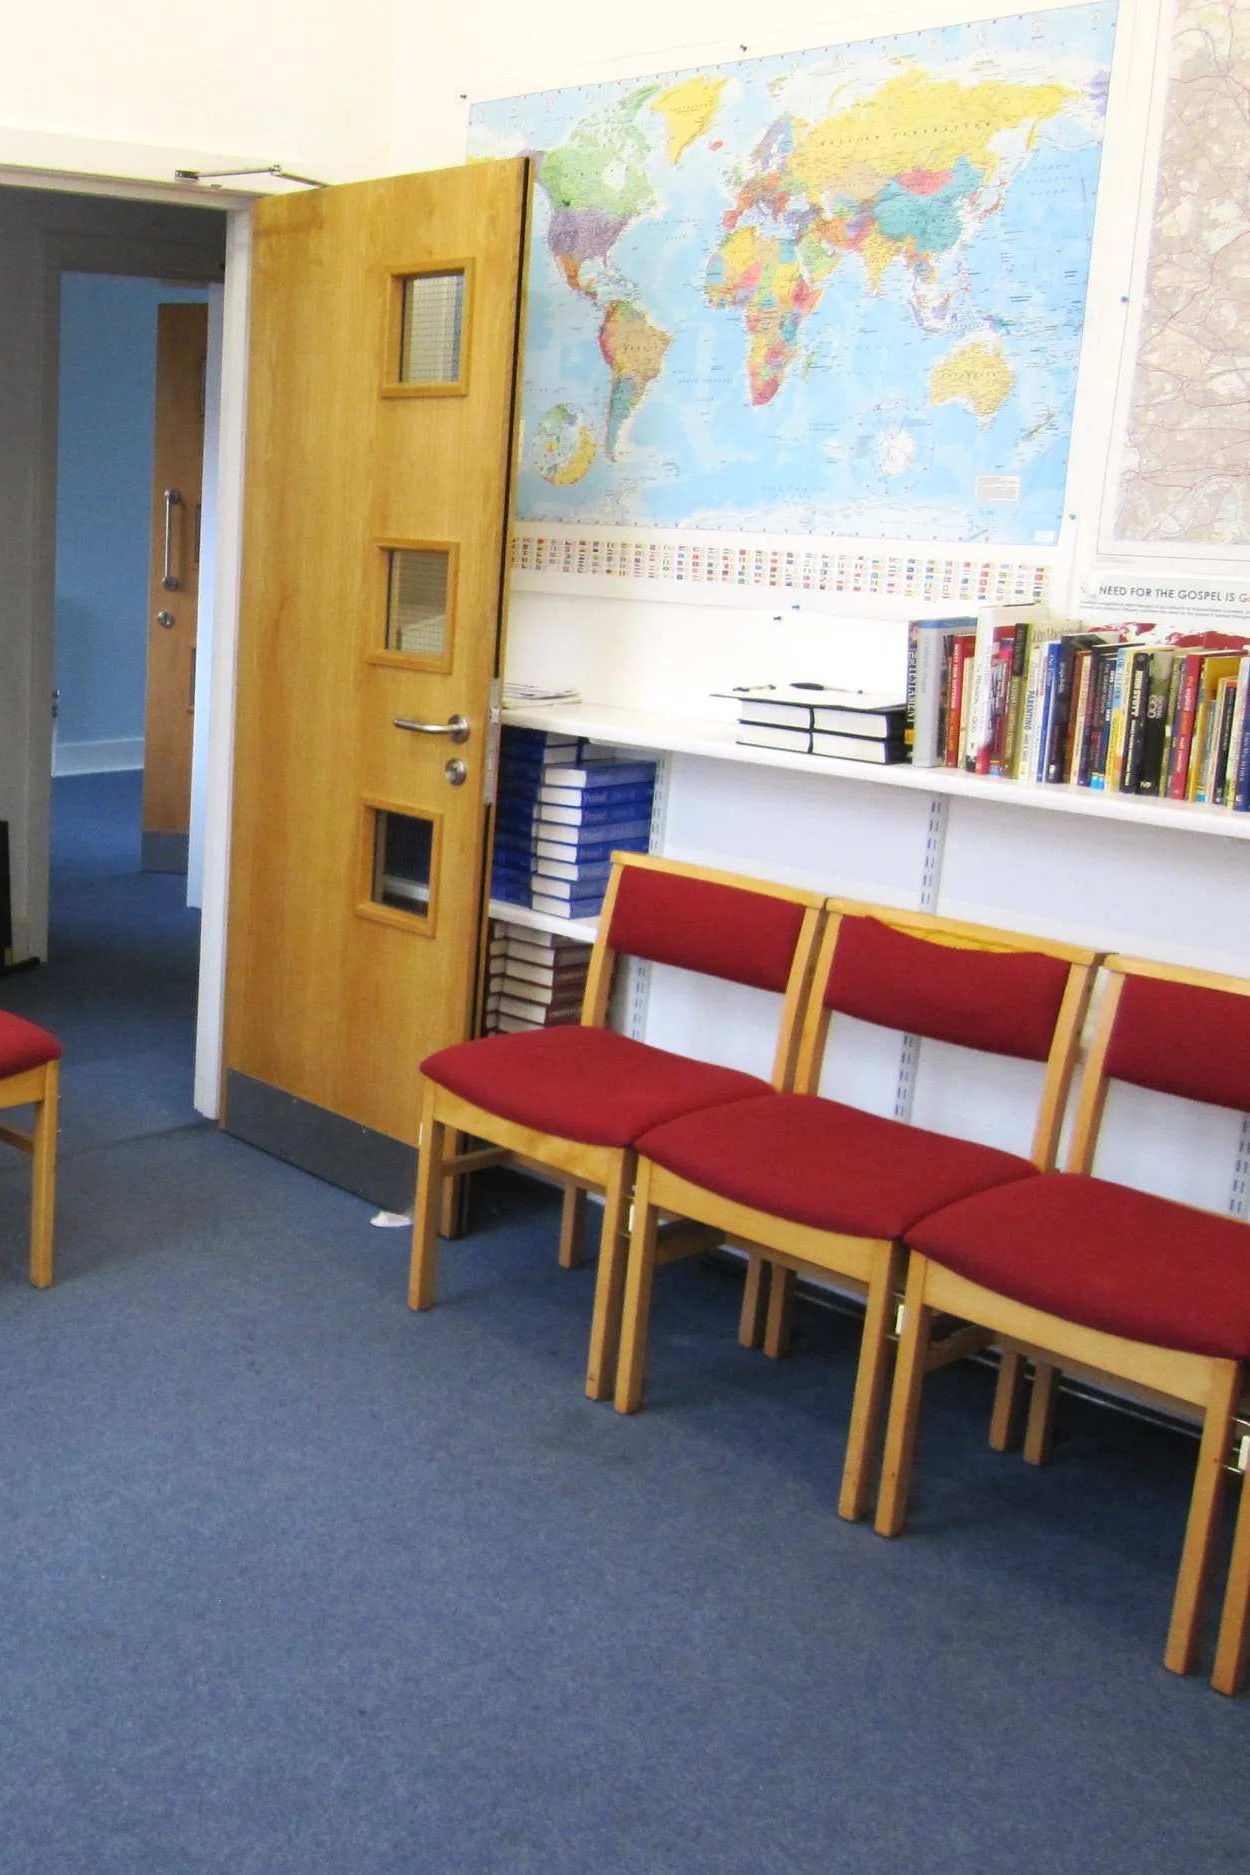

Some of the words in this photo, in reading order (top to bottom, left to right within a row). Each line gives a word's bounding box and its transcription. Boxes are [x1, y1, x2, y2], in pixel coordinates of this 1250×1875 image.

[1098, 585, 1127, 596] NEED
[1130, 587, 1152, 597] FOR
[1155, 588, 1174, 599] THE
[1178, 589, 1222, 602] GOSPEL
[1225, 592, 1235, 602] IS
[1134, 670, 1144, 689] JOHN
[907, 668, 917, 722] TESTAMENT
[1131, 689, 1143, 717] STOTT
[1183, 688, 1192, 711] explicit
[1024, 690, 1035, 730] PARENTING
